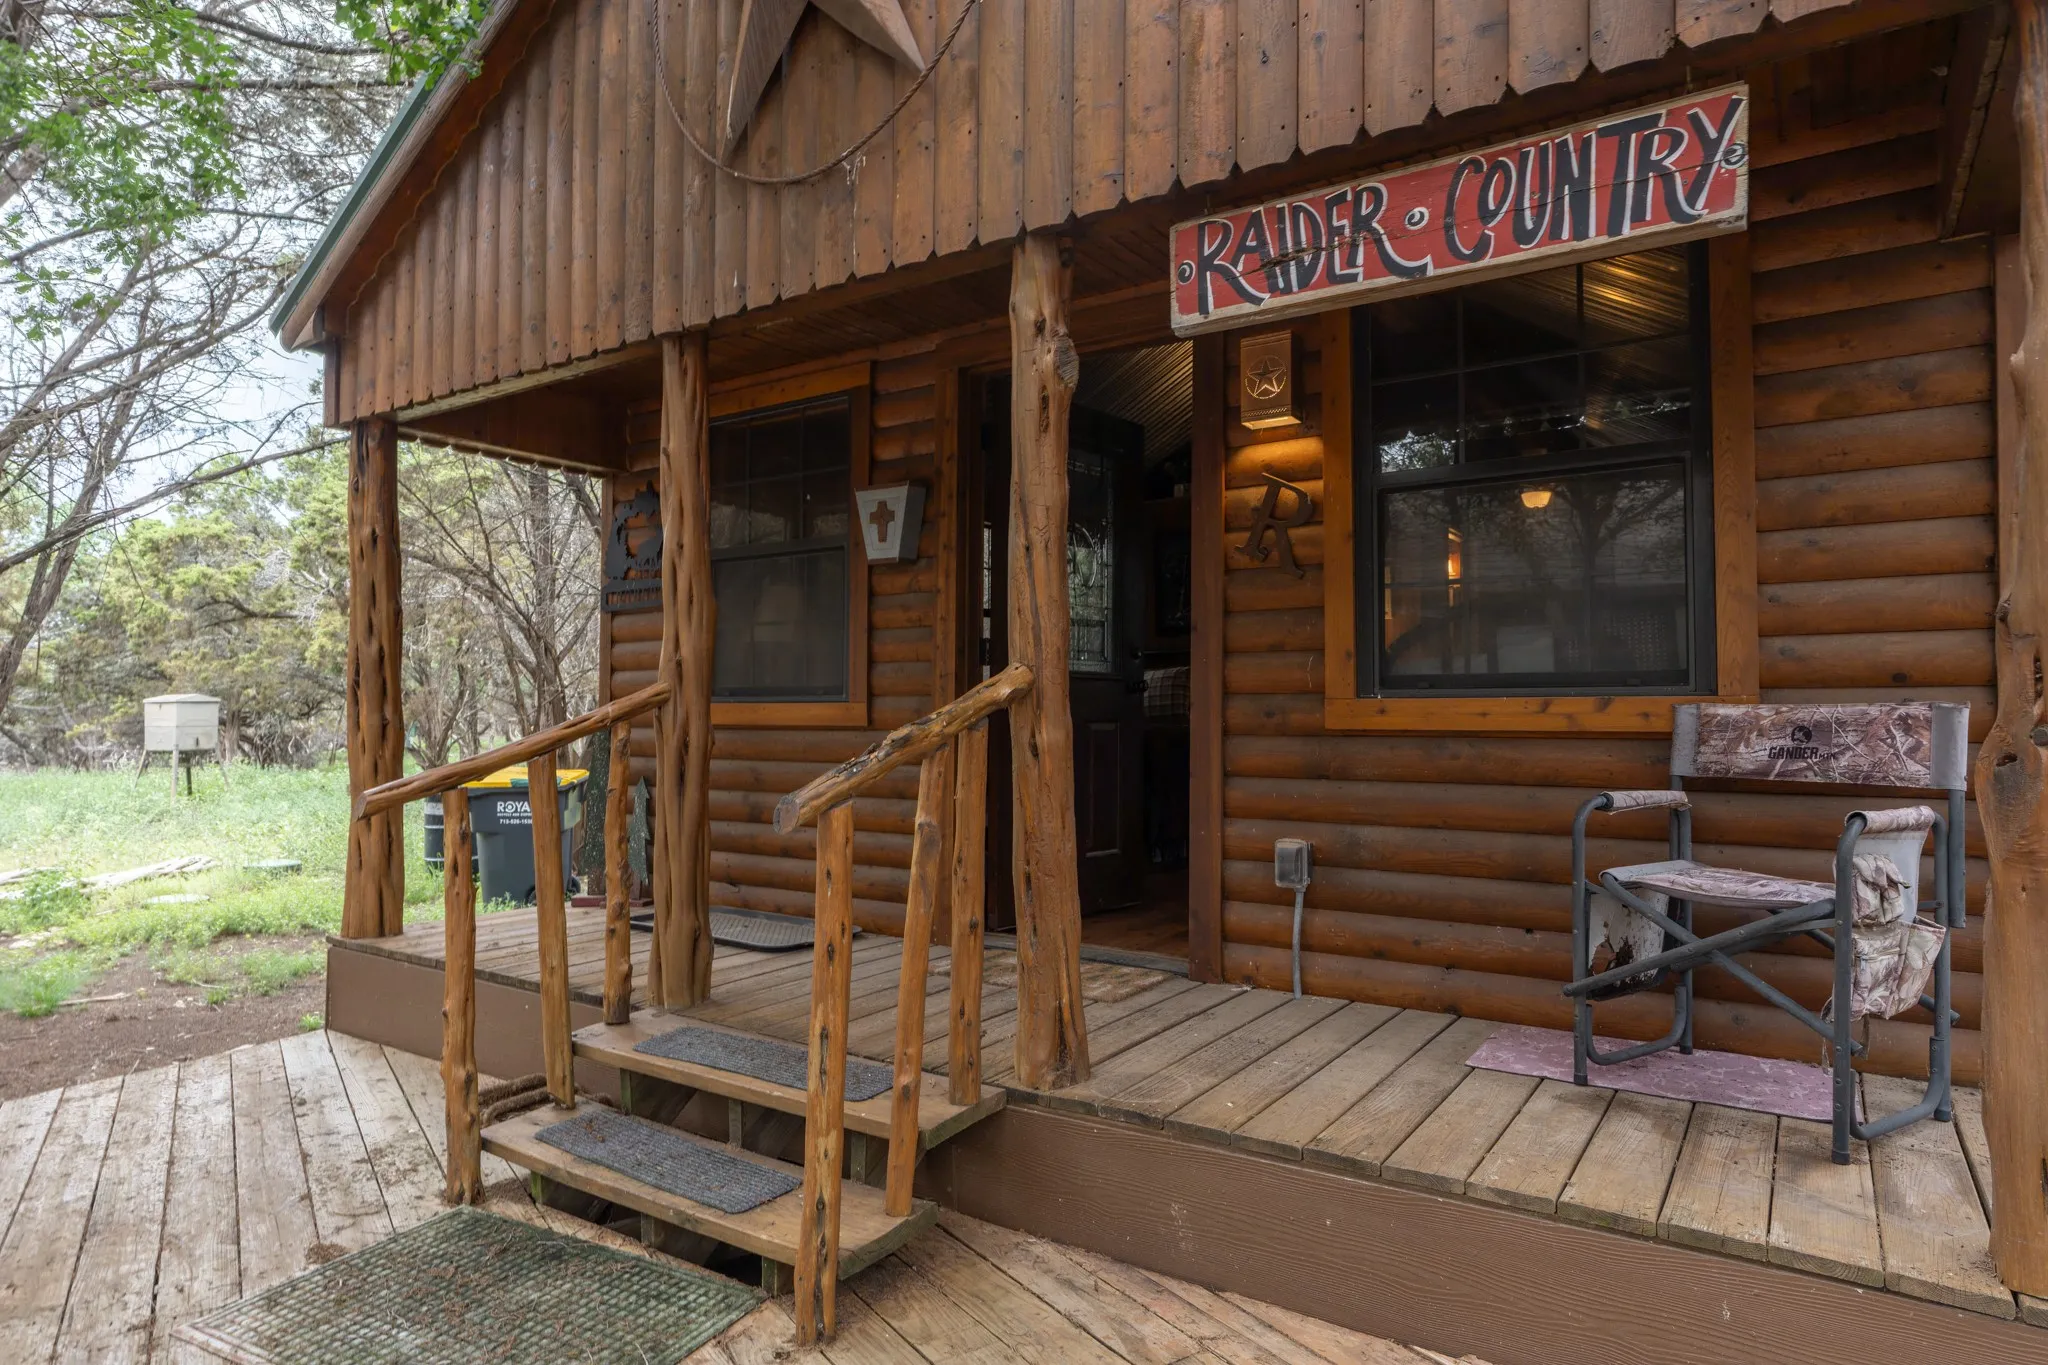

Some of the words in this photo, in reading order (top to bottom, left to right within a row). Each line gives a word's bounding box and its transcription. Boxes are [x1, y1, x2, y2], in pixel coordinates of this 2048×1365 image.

[1197, 181, 1435, 317] RAIDER
[1444, 93, 1747, 264] COUNTRY
[1768, 746, 1819, 760] GANDER
[497, 801, 531, 812] ROYA
